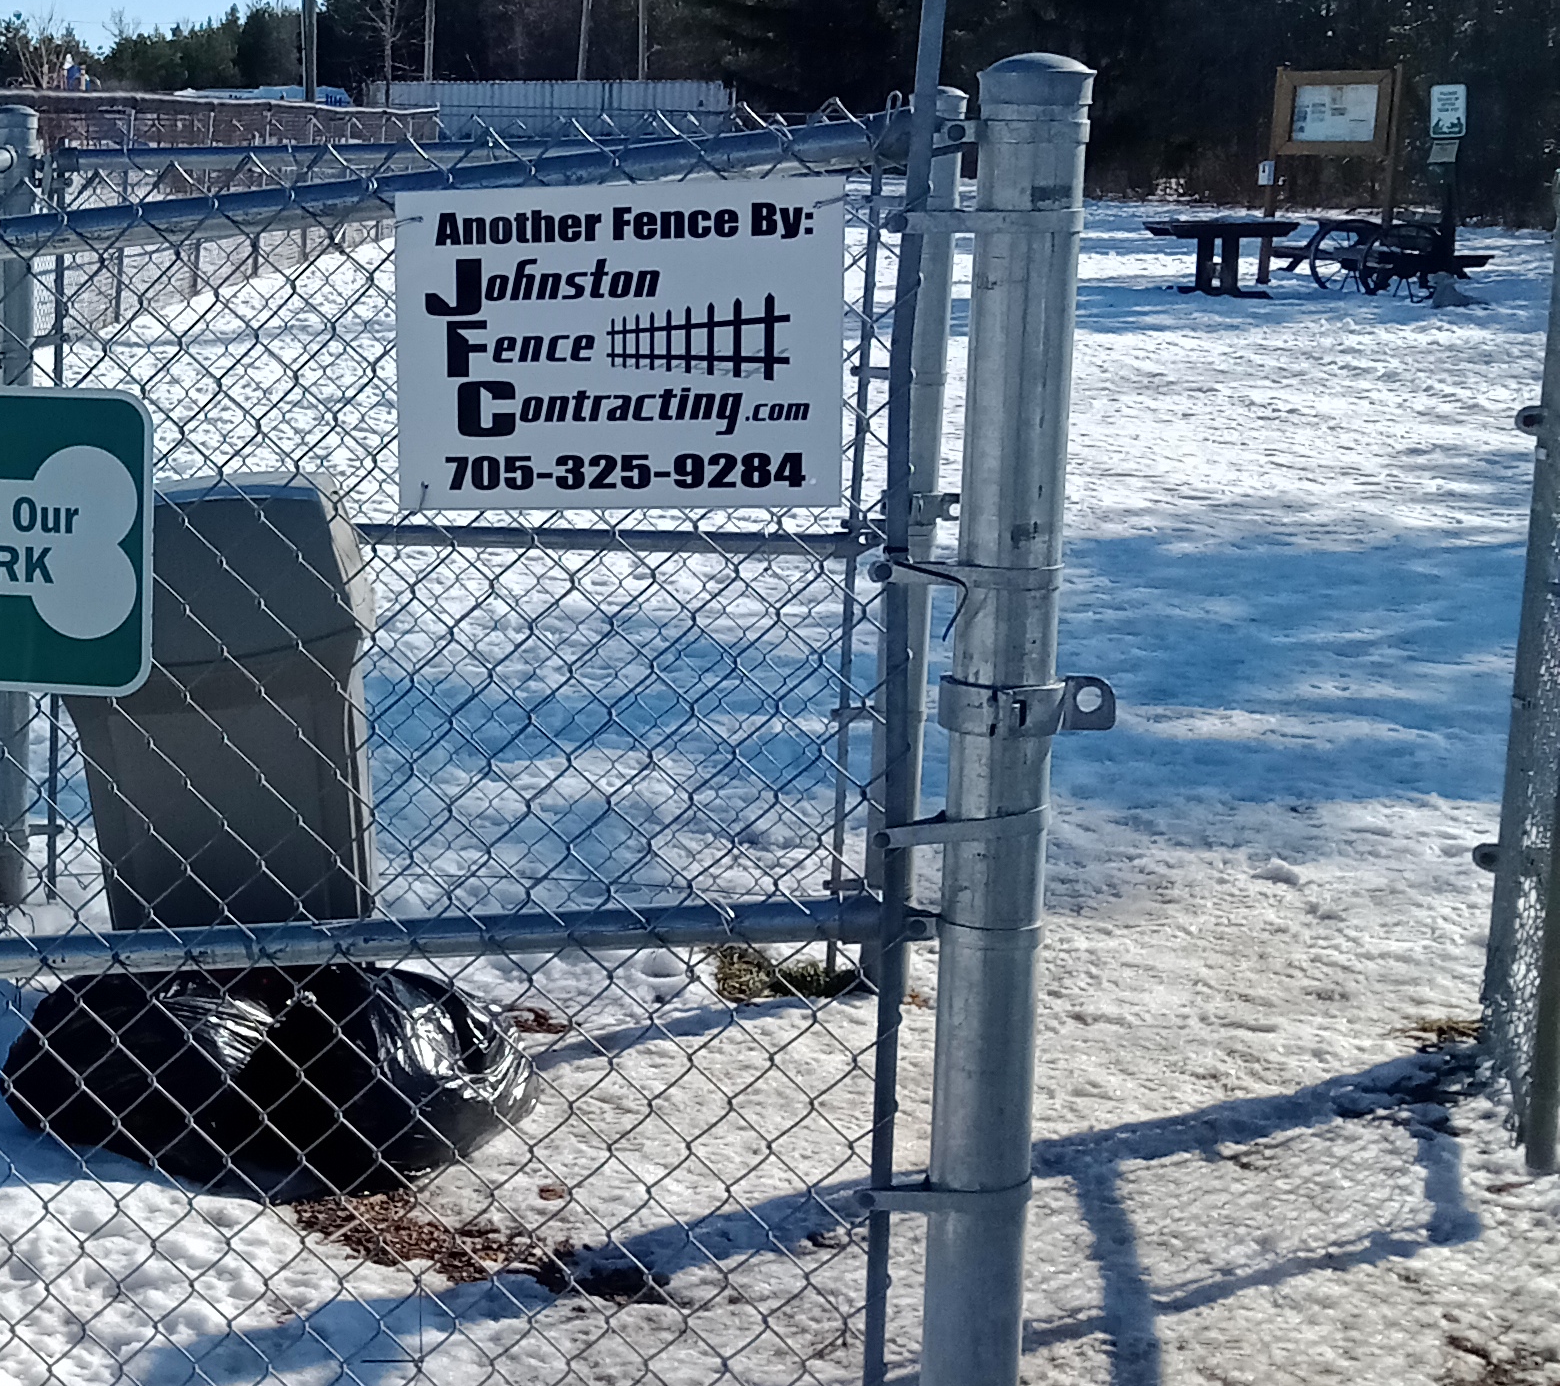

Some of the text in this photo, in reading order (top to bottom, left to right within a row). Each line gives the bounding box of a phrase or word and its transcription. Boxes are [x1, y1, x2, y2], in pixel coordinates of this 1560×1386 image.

[434, 202, 814, 247] Another Fence By:
[424, 258, 661, 317] Johnston
[446, 319, 596, 378] Fence
[445, 452, 806, 491] 705-325-9284
[12, 496, 80, 535] Our
